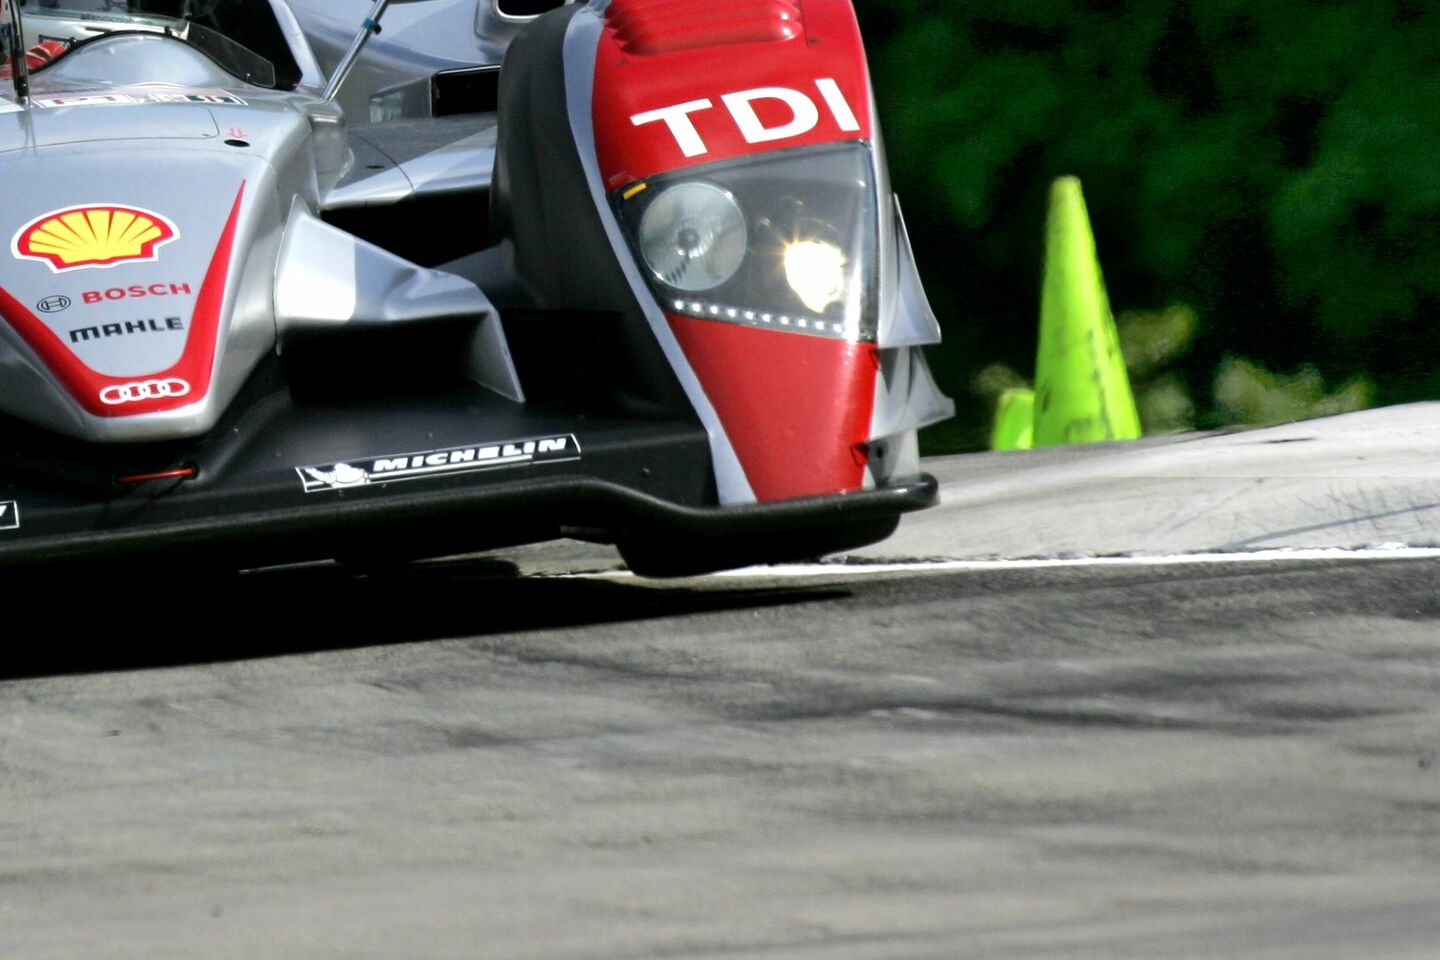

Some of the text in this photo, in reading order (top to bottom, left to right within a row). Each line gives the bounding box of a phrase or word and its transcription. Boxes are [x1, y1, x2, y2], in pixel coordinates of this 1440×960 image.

[629, 77, 861, 158] TDI
[82, 283, 192, 305] BOSCH
[69, 316, 185, 344] MAHLE
[373, 437, 566, 472] MICHELIN
